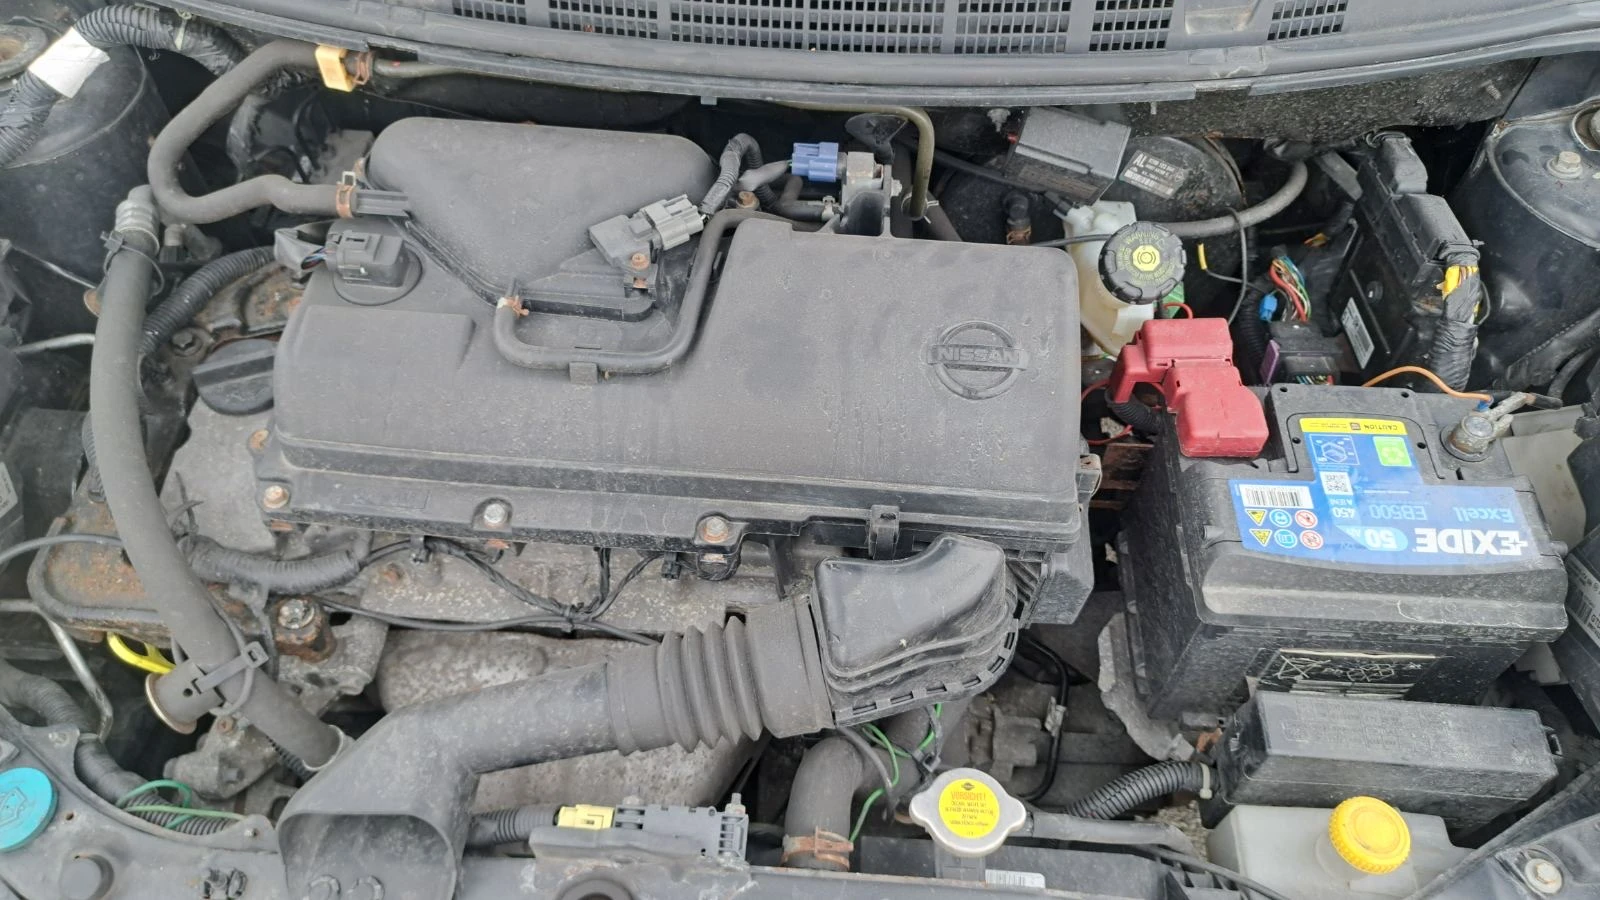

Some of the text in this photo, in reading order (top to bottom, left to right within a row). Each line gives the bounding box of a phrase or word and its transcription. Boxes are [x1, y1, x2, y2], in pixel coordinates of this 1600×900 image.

[1133, 153, 1147, 168] AL
[1125, 231, 1159, 244] WARNING
[938, 346, 1020, 364] NISSAN
[1363, 423, 1398, 431] CAUTION
[1332, 507, 1355, 519] 450
[1370, 504, 1427, 521] EB500
[1455, 506, 1516, 524] Excell
[1365, 529, 1395, 549] 50
[1415, 527, 1529, 556] EXIDE
